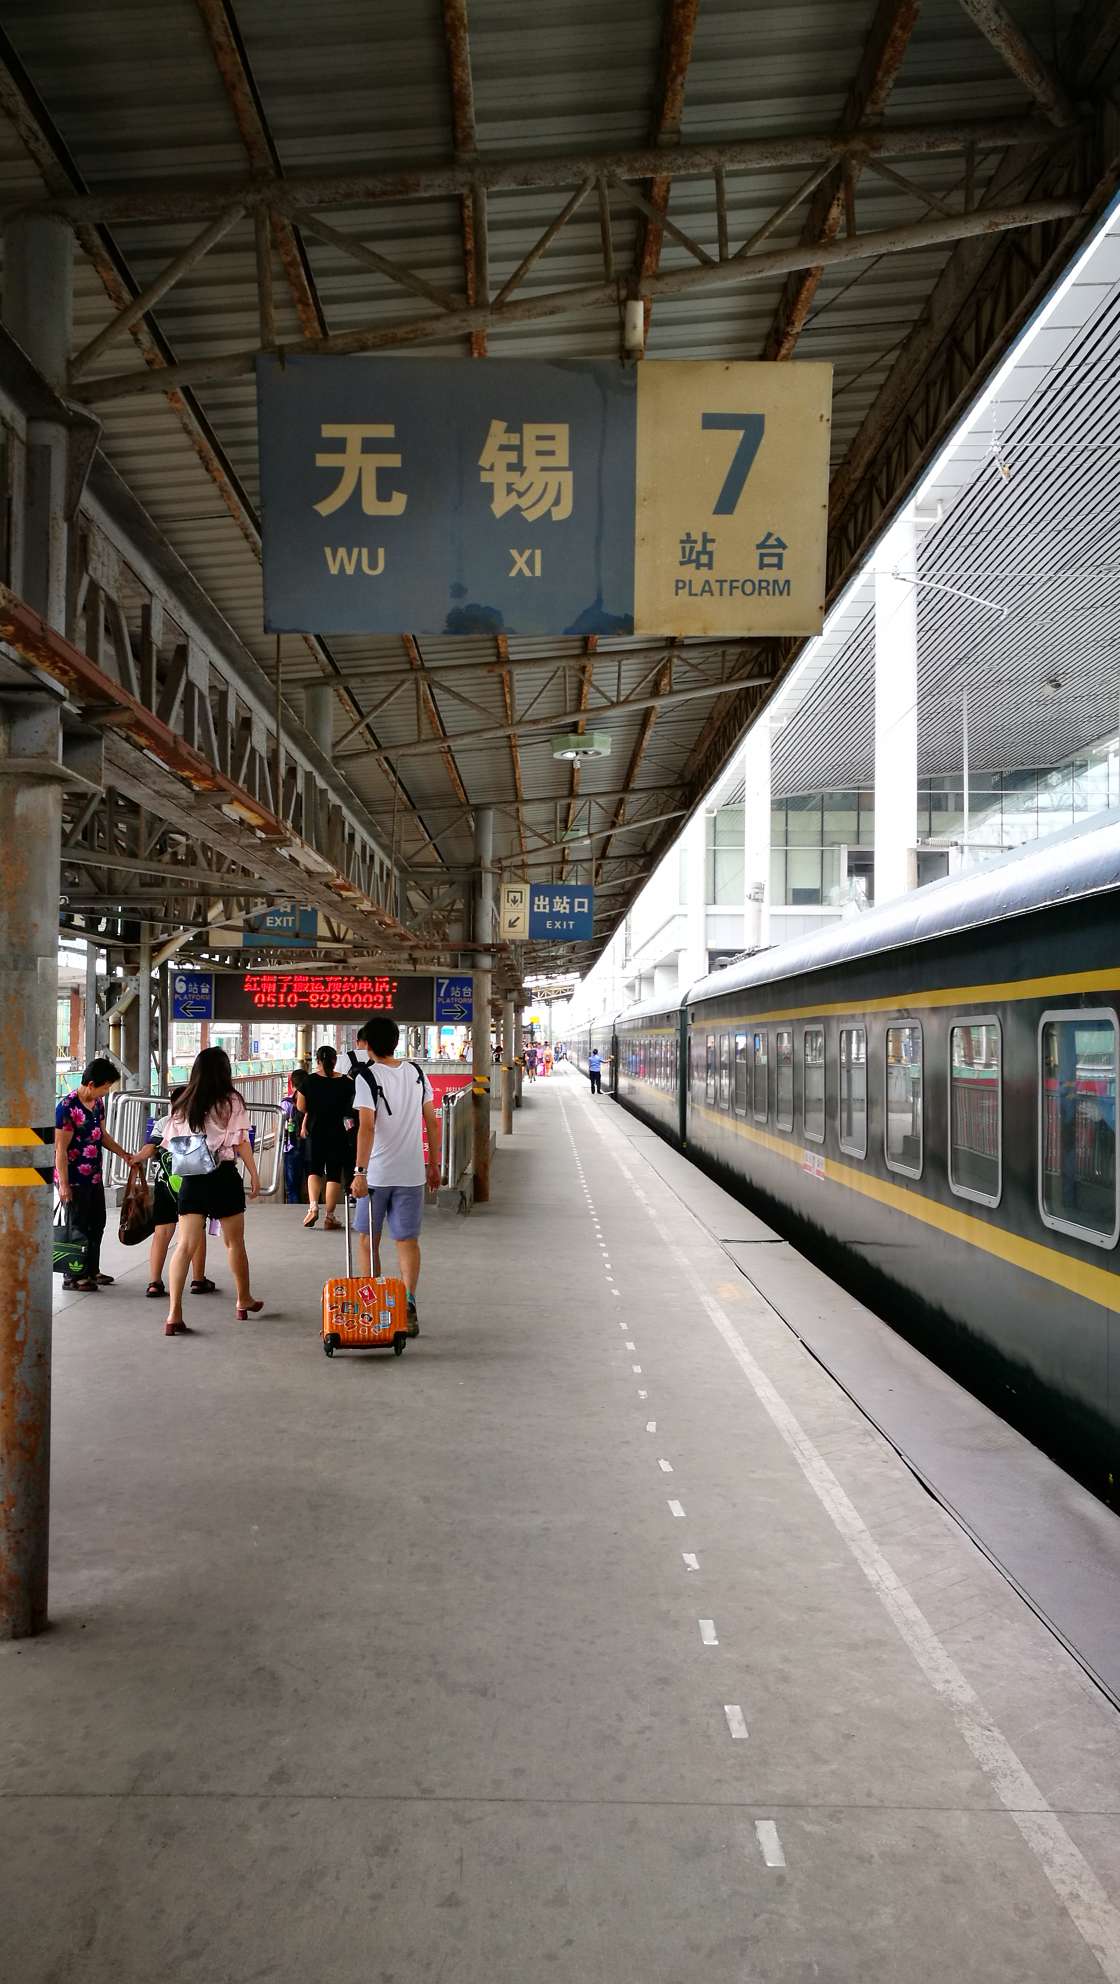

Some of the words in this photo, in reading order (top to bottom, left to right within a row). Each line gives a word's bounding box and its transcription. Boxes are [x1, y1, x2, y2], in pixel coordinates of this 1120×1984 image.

[701, 412, 765, 516] 7
[679, 531, 789, 571] 站台
[324, 546, 385, 575] WU
[508, 548, 542, 577] XI
[674, 578, 792, 597] PLATFORM
[533, 895, 589, 913] 出站口
[266, 916, 295, 927] EXIT
[545, 920, 576, 929] EXIT
[175, 975, 187, 993] 6
[187, 982, 210, 993] 站台
[438, 979, 449, 997] 7
[450, 985, 472, 997] 站台
